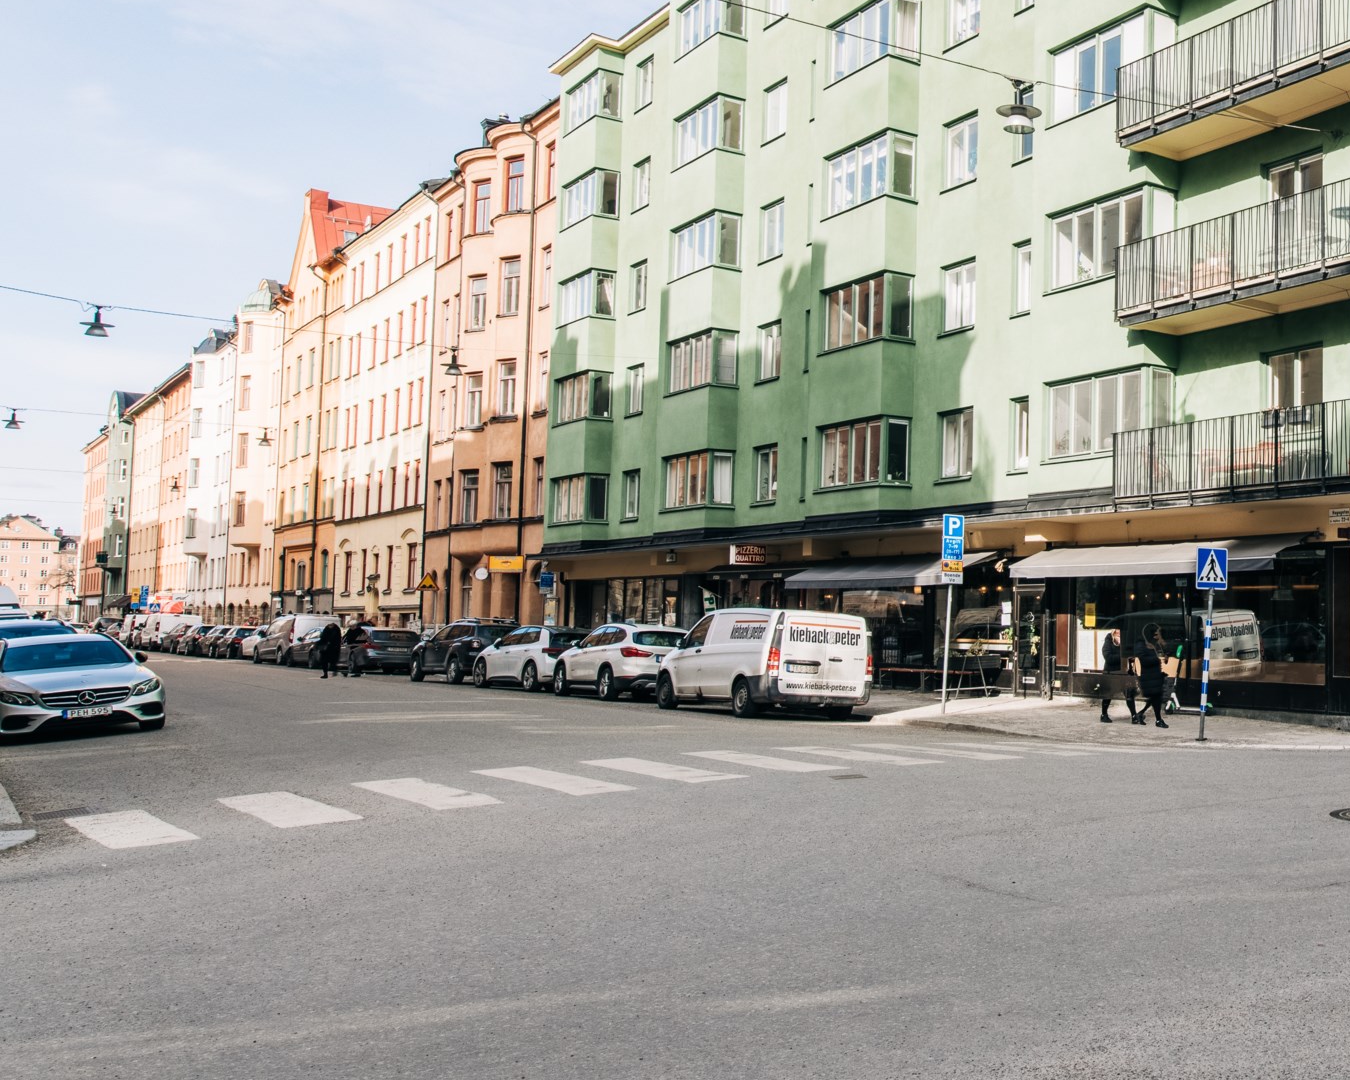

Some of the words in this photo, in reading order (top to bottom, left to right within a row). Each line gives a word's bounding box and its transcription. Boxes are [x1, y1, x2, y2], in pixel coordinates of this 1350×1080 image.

[948, 517, 960, 535] P
[735, 546, 766, 554] PIZZERIA
[786, 682, 857, 693] www.kieback-peter.se
[70, 709, 89, 717] PEH
[91, 707, 109, 715] 595
